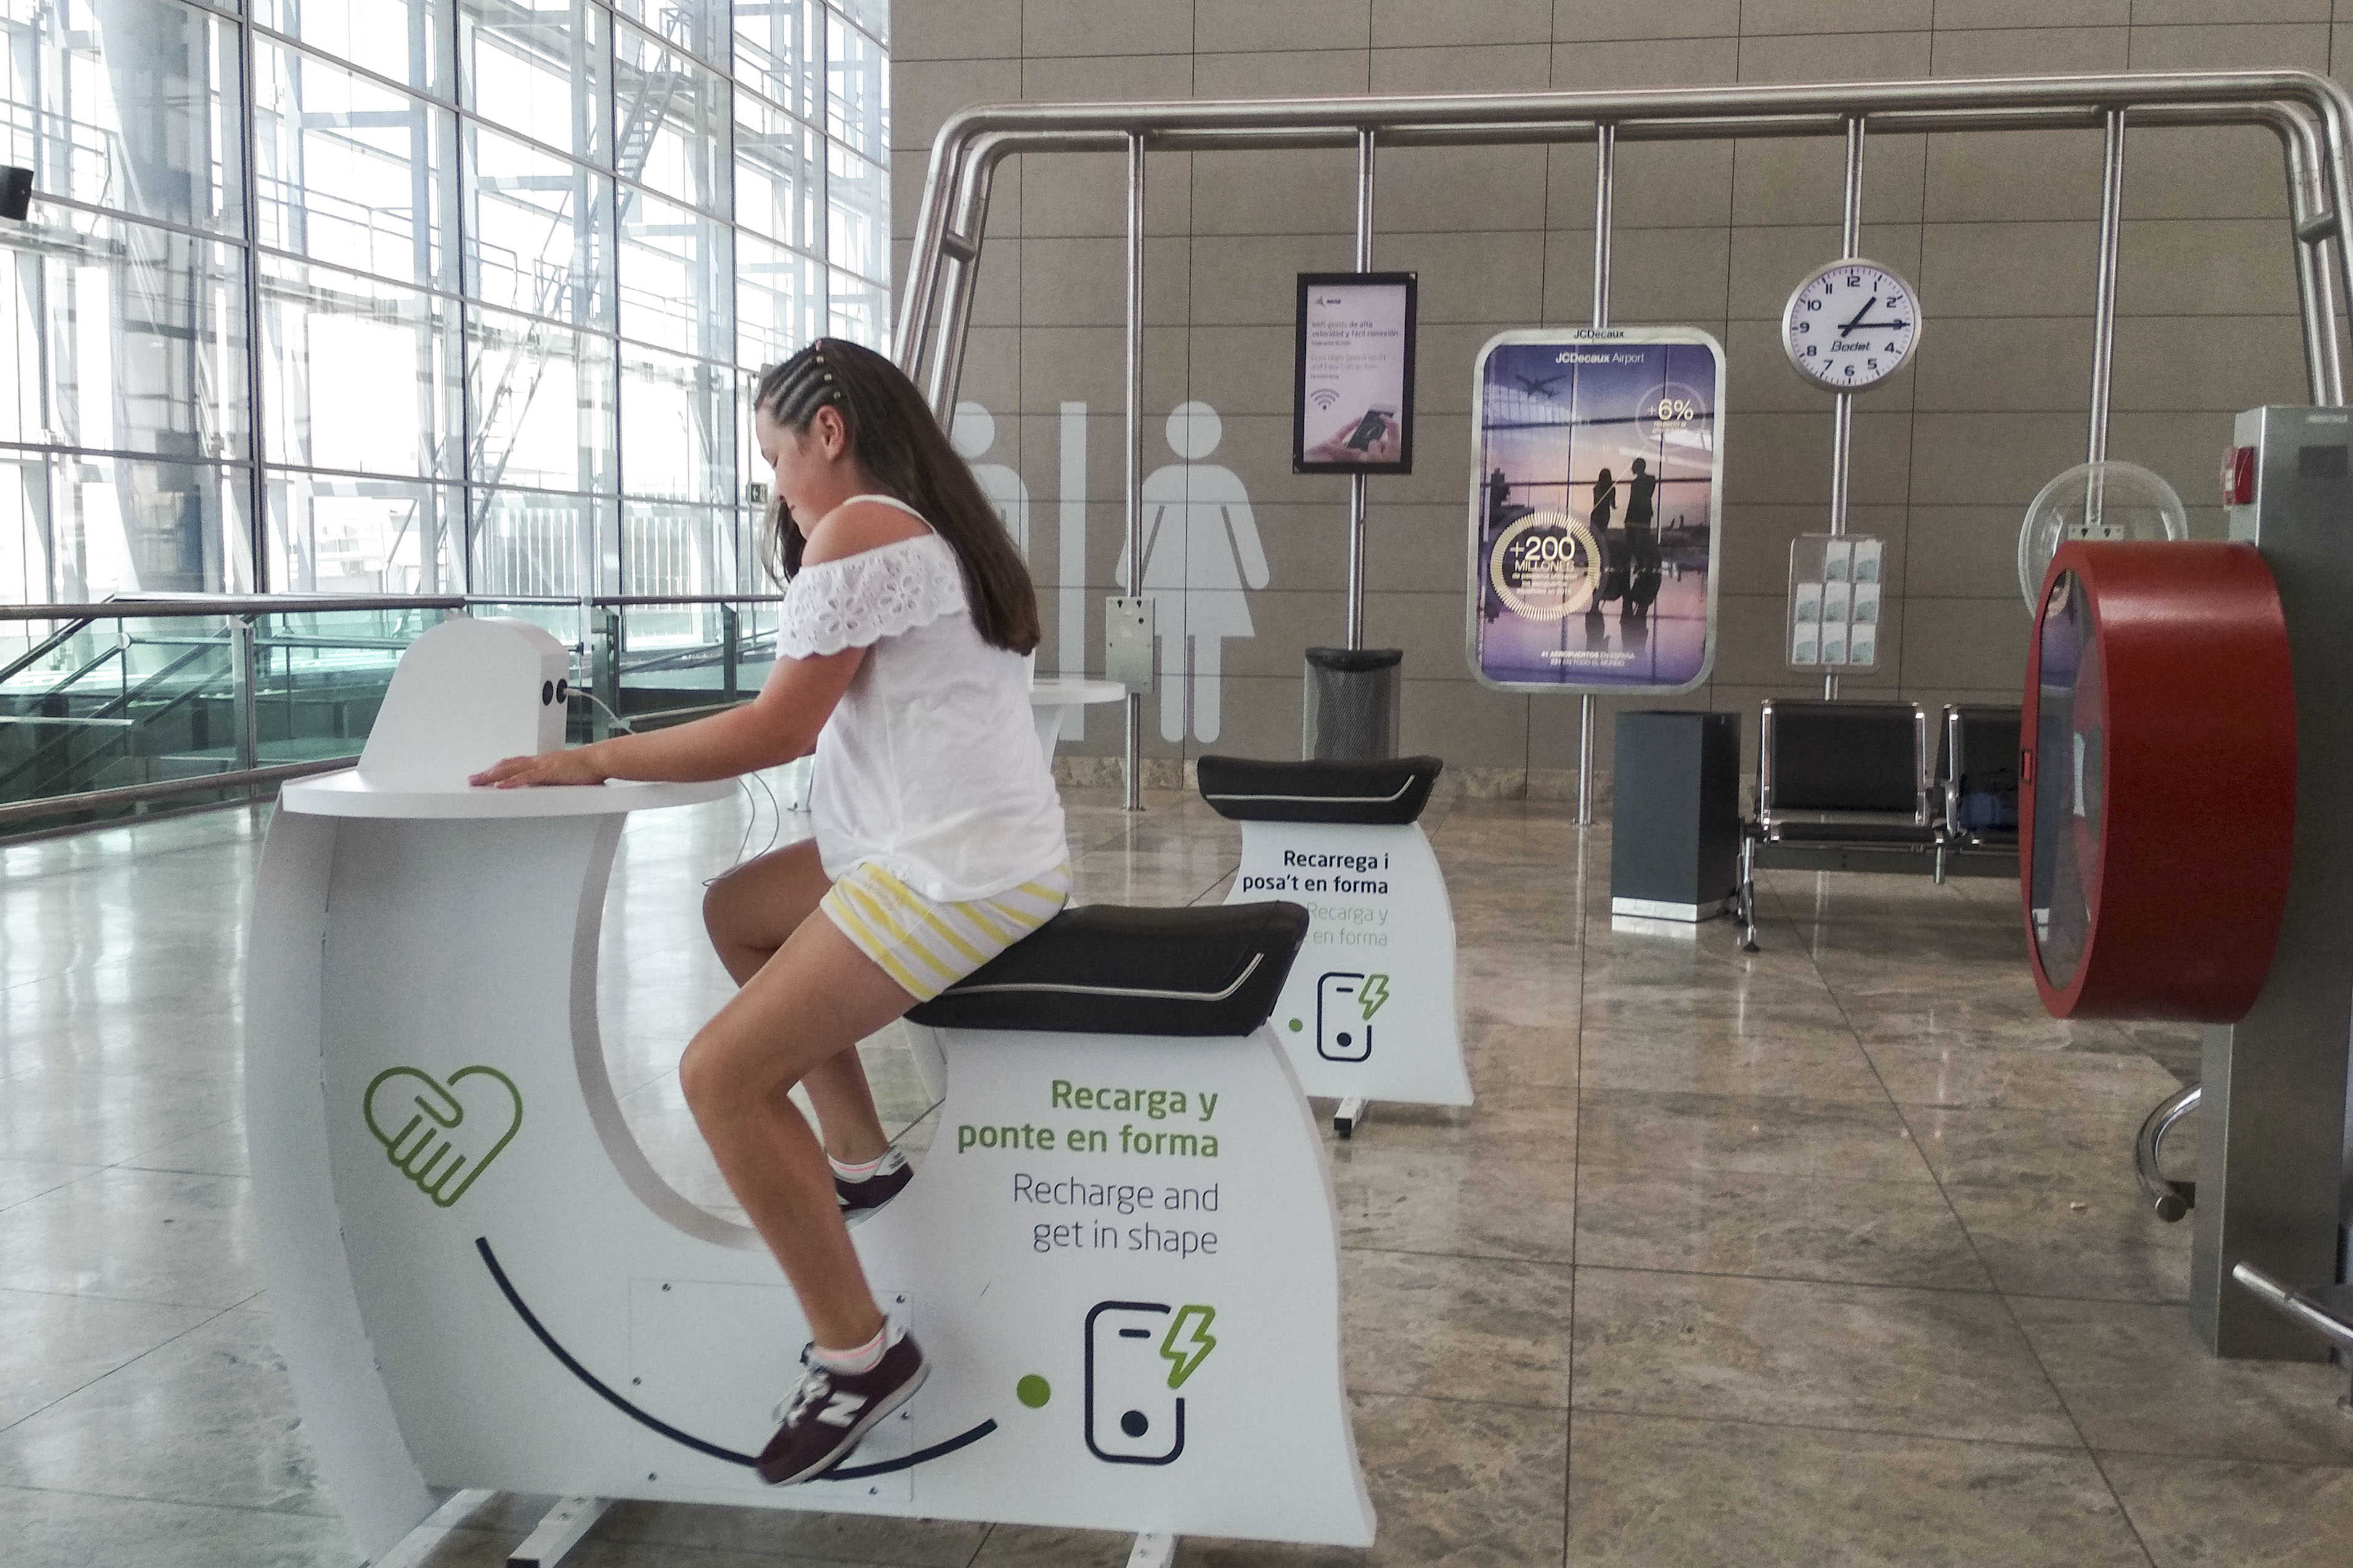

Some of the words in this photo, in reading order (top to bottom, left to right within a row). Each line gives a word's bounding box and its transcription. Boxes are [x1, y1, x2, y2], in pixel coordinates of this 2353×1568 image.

[1847, 277, 1860, 287] 12
[1874, 282, 1877, 291] 1
[1825, 284, 1832, 294] 11
[1808, 300, 1822, 311] 10
[1886, 297, 1896, 308] 2
[1800, 322, 1809, 333] 9
[1573, 330, 1625, 339] JCDecaux
[1807, 346, 1817, 356] 8
[1830, 341, 1870, 352] Bodet
[1884, 343, 1894, 353] 4
[1556, 352, 1610, 364] JCDecaux
[1612, 352, 1645, 365] Airport
[1824, 360, 1833, 370] 7
[1867, 359, 1877, 370] 5
[1845, 365, 1854, 376] 6
[1647, 398, 1694, 421] +6%
[1510, 536, 1575, 561] +200
[1514, 559, 1575, 572] MILLONES
[1284, 850, 1377, 872] Recarrega
[1384, 853, 1389, 869] i
[1243, 874, 1299, 892] posa't
[1305, 878, 1326, 892] en
[1334, 876, 1388, 894] forma
[1307, 901, 1374, 925] Recarga
[1379, 909, 1389, 925] y
[1313, 929, 1333, 944] en
[1340, 927, 1387, 947] forma
[1052, 1079, 1186, 1119] Recarga
[1199, 1092, 1218, 1121] y
[958, 1123, 1055, 1154] ponte
[1067, 1128, 1107, 1152] en
[1119, 1124, 1218, 1157] forma
[1014, 1173, 1153, 1215] Recharge
[1164, 1182, 1218, 1212] and
[1034, 1221, 1083, 1253] get
[1094, 1219, 1117, 1249] in
[1128, 1221, 1218, 1259] shape
